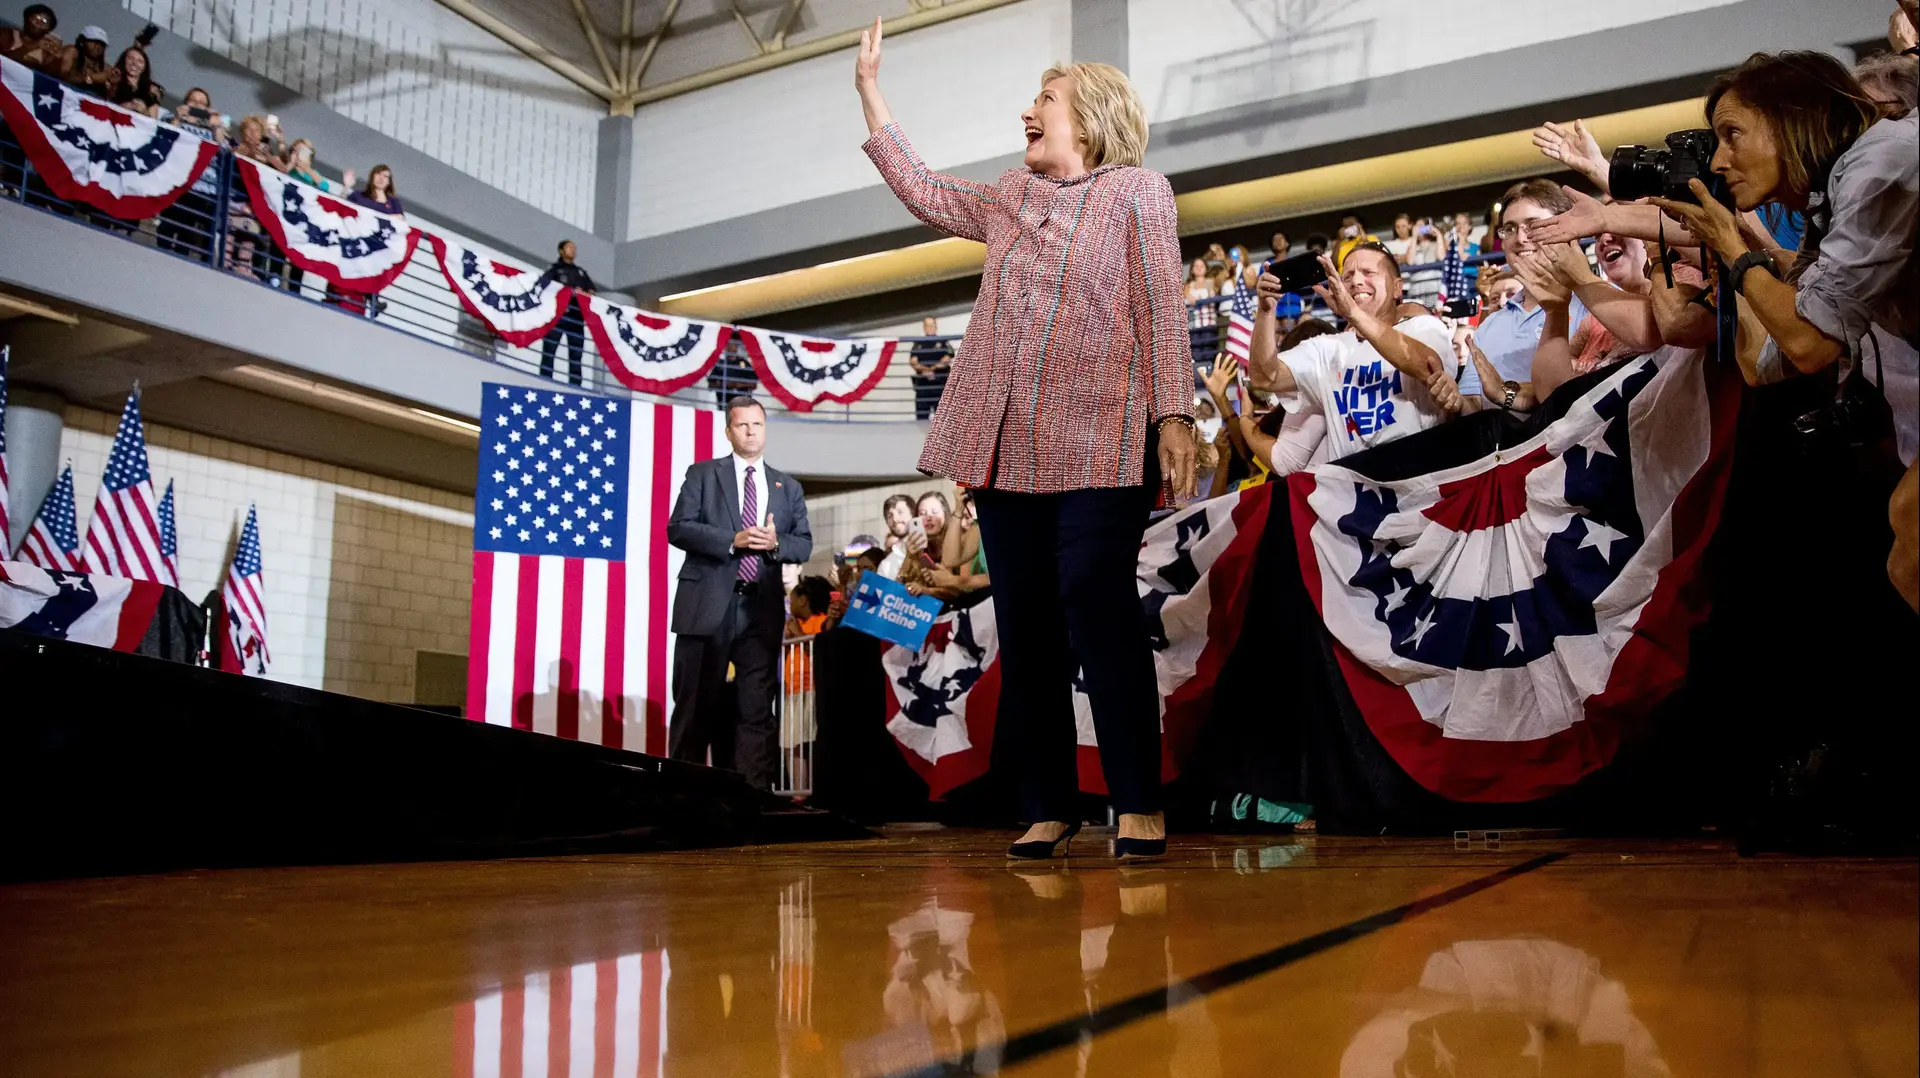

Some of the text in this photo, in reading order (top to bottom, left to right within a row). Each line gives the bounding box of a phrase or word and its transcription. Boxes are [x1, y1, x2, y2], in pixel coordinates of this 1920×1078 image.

[1343, 360, 1382, 387] I'M
[1345, 400, 1397, 441] HER
[878, 605, 917, 630] Kaine
[883, 594, 932, 622] Clinton
